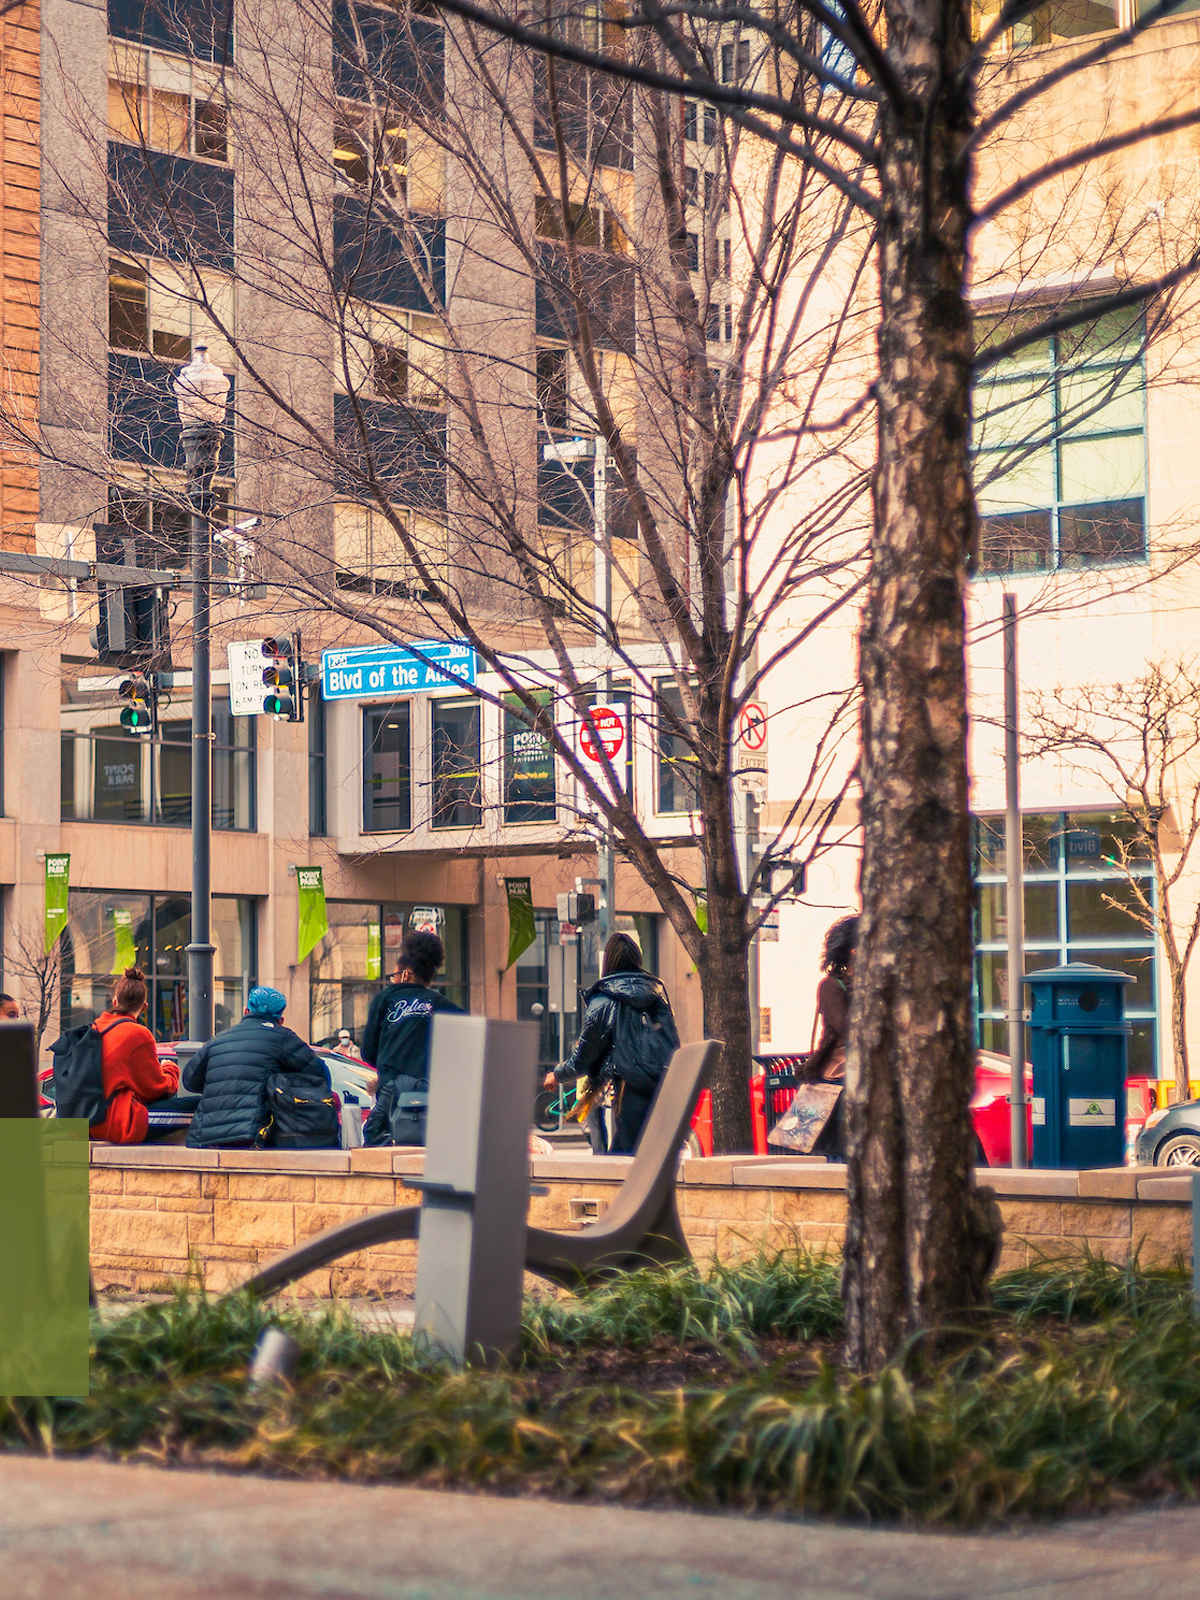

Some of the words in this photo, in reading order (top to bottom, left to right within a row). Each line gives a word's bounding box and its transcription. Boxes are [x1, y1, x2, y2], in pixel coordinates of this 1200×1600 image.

[245, 650, 259, 660] NO
[449, 646, 468, 656] 300
[330, 669, 362, 692] Blvd
[369, 668, 386, 687] of
[392, 665, 417, 686] the
[236, 681, 248, 692] ON
[254, 680, 265, 690] RE
[601, 718, 615, 728] NOT
[741, 757, 766, 768] EXCEPT
[48, 858, 68, 867] POINT
[299, 871, 320, 879] POINT
